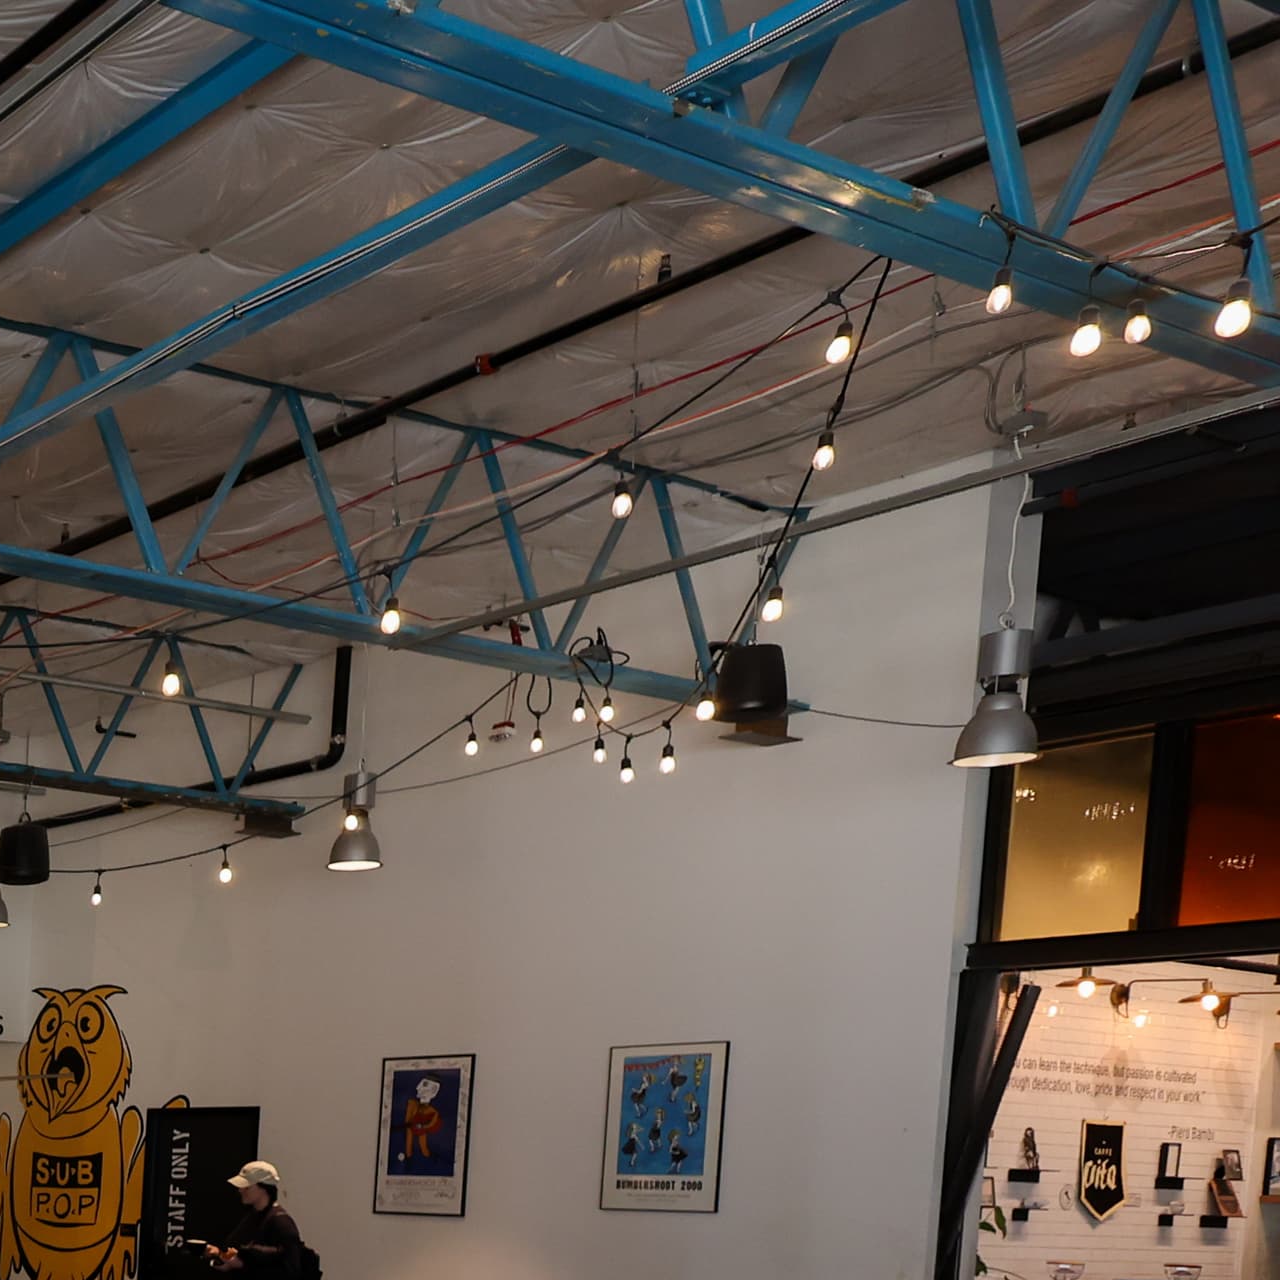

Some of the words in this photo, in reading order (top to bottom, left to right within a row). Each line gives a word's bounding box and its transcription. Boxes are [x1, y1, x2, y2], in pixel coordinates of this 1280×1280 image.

[170, 1128, 191, 1180] ONLY
[680, 1181, 703, 1191] 2000
[166, 1184, 187, 1248] STAFF
